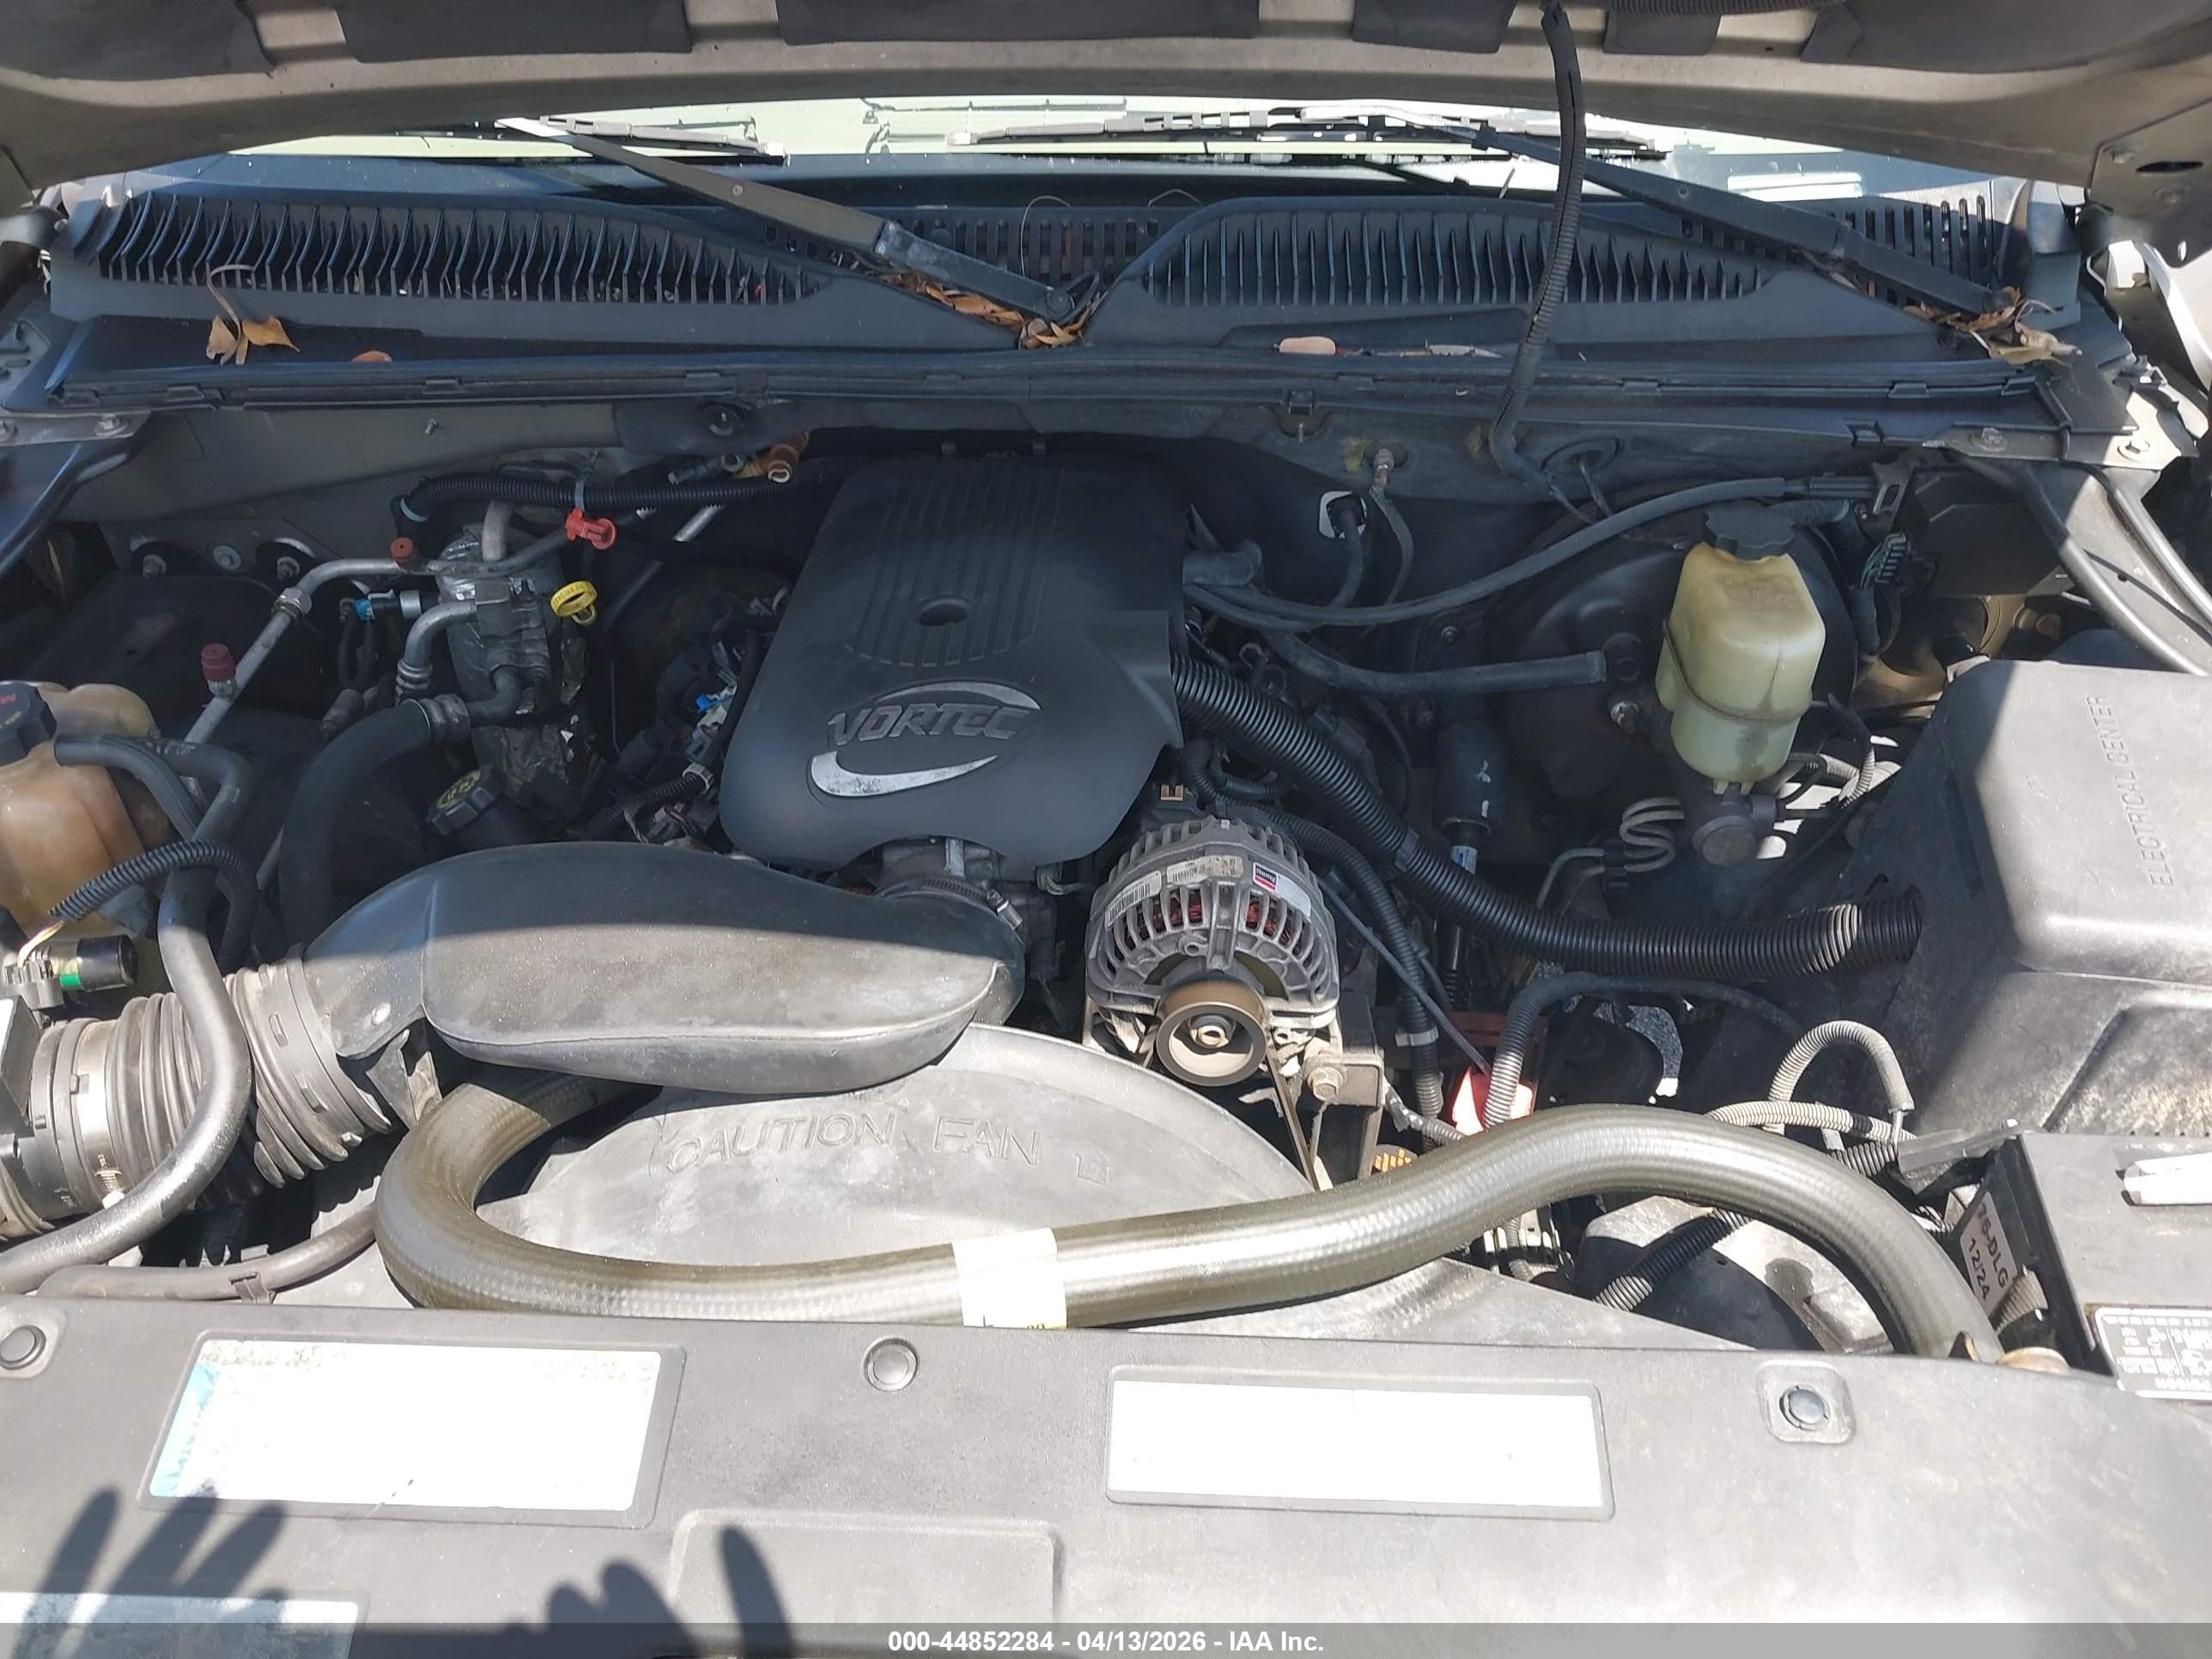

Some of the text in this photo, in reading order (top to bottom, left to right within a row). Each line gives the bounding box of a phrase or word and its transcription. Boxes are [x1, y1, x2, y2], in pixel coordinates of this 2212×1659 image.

[827, 702, 1031, 746] VORTEC
[2086, 695, 2175, 887] ELECTRICAL CENTER
[665, 1112, 1042, 1174] CAUTION FAN
